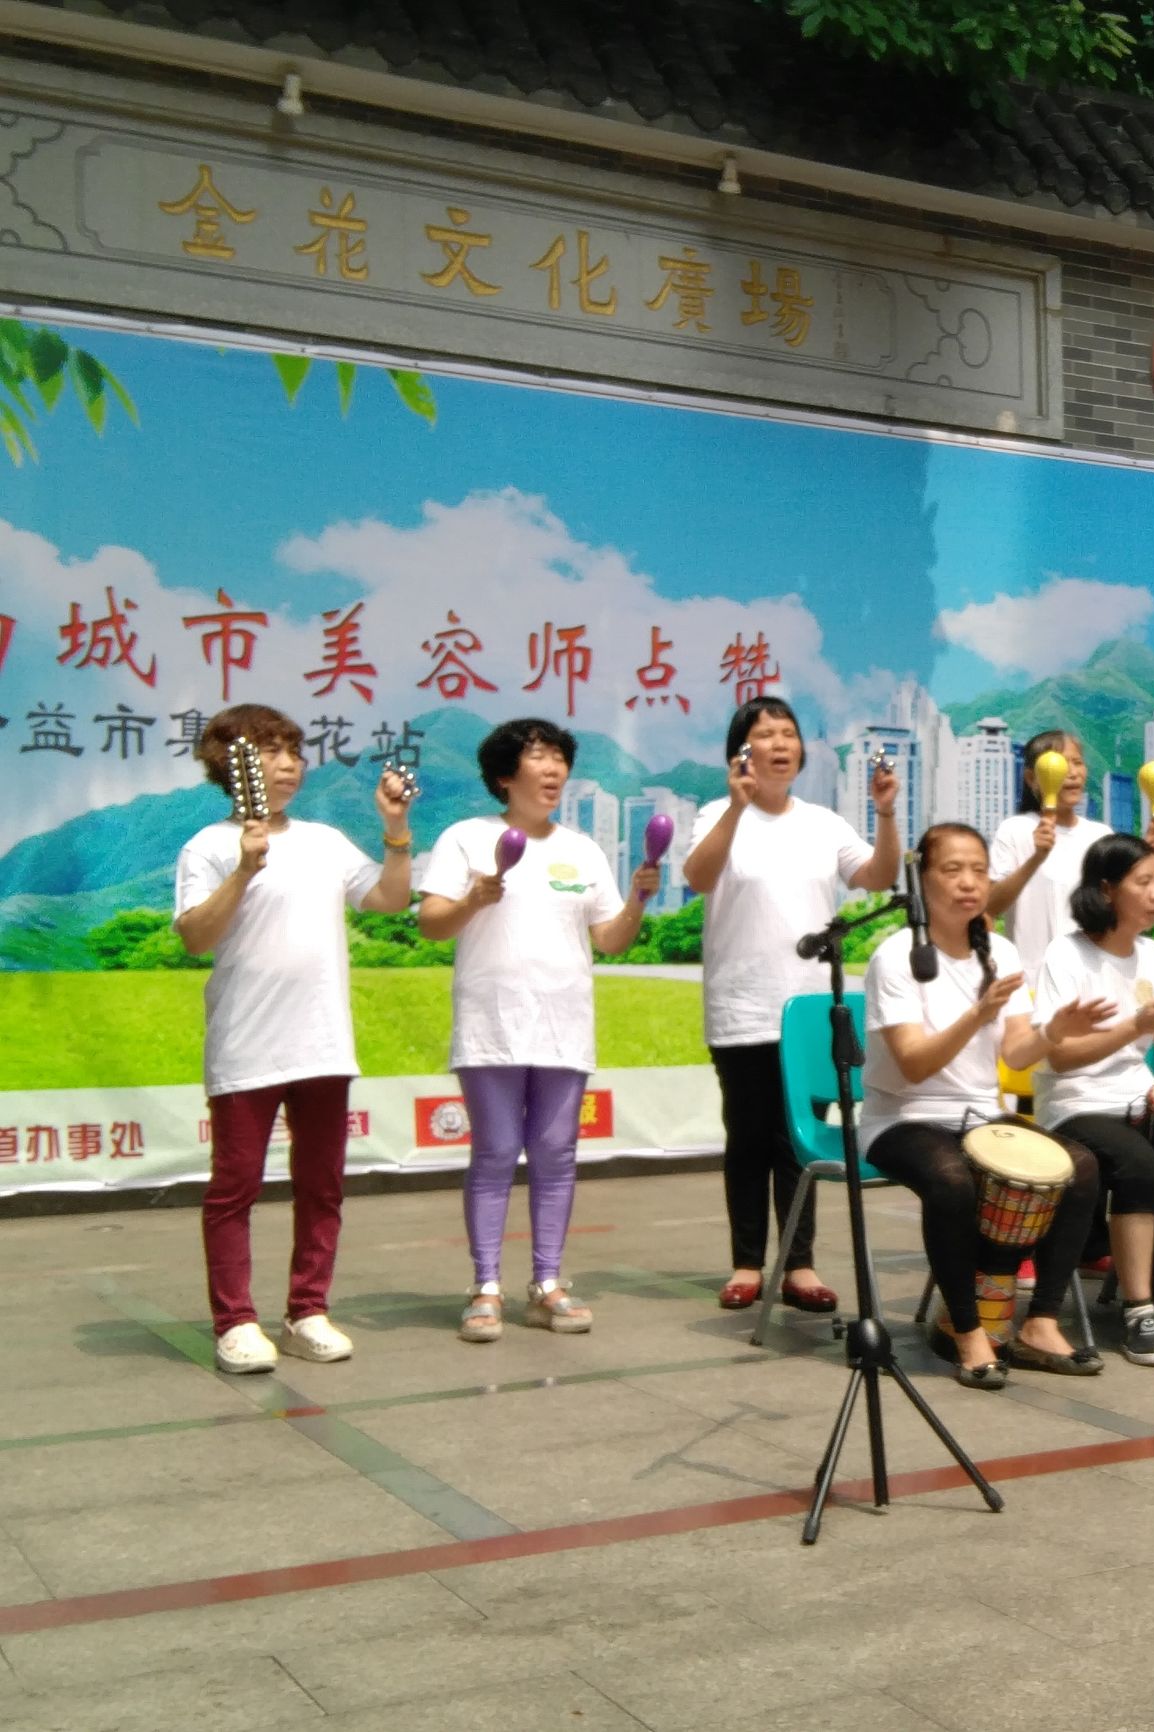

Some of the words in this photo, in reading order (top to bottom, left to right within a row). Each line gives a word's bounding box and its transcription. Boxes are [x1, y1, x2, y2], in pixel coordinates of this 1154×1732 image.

[158, 164, 815, 349] 金花文化廣場
[0, 585, 781, 717] 城市美容师点赞
